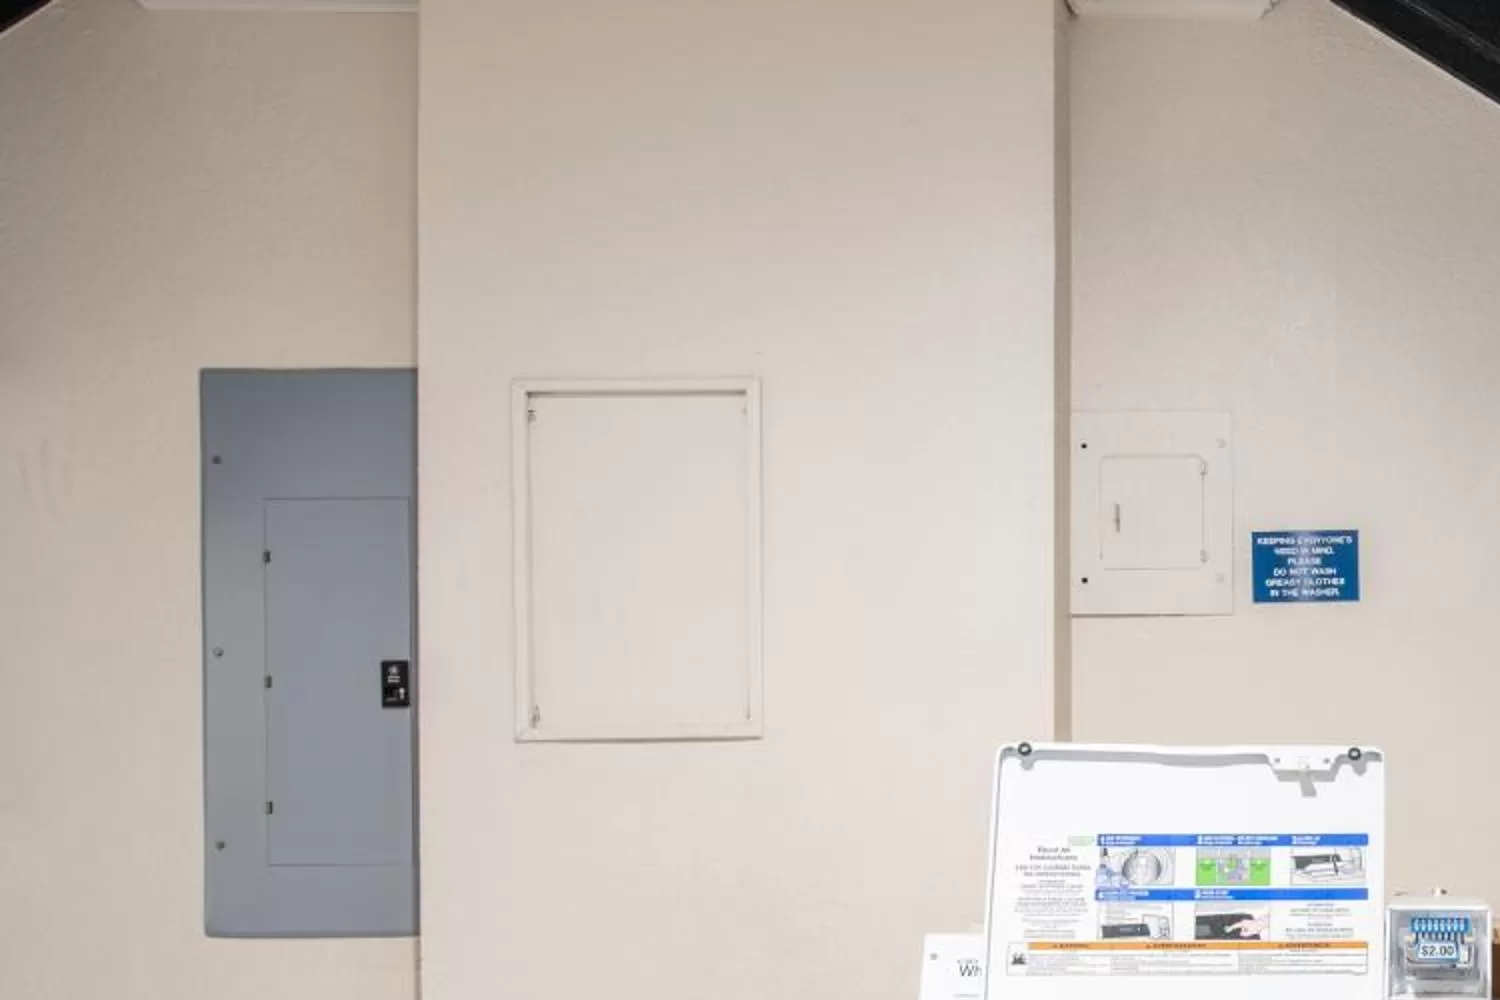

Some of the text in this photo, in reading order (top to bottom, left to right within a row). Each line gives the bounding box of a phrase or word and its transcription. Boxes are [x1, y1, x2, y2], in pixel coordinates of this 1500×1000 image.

[1287, 557, 1322, 565] PLEASE
[1273, 566, 1337, 576] DO NOT WASH
[1265, 577, 1345, 587] GREASY CLOTHES
[1269, 589, 1279, 597] IN
[1281, 589, 1299, 597] THE
[1421, 945, 1454, 956] $2.00
